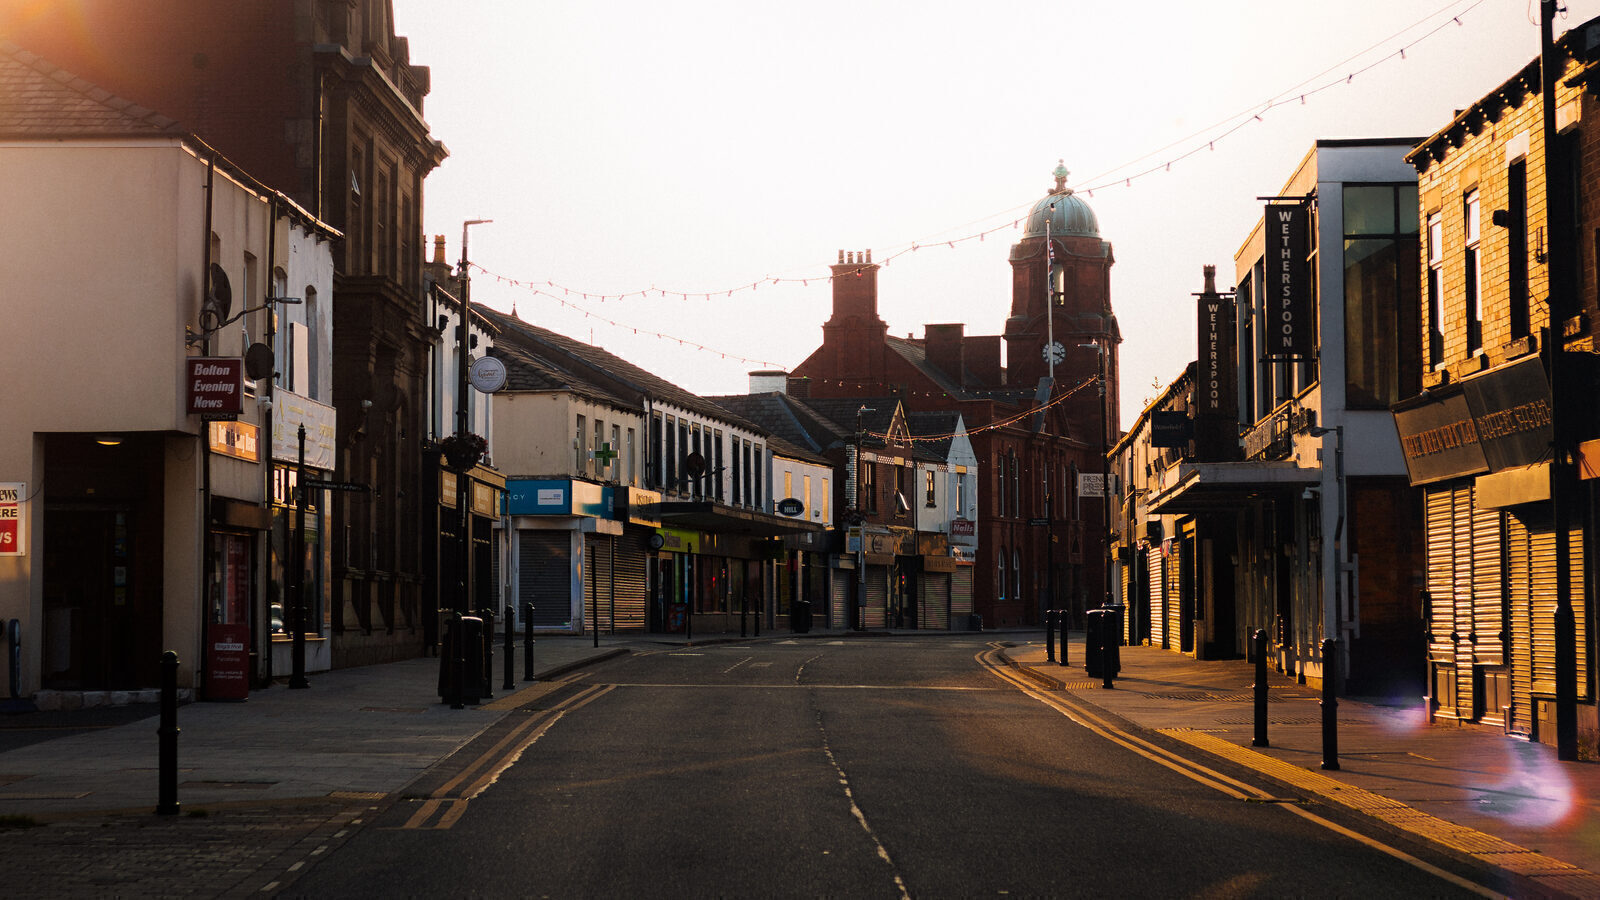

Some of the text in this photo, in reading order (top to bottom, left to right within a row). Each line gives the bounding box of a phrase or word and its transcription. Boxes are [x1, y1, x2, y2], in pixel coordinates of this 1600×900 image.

[1278, 211, 1292, 347] WETHERSPOON
[1208, 303, 1219, 409] WETHERSPOON
[194, 363, 230, 376] Bolton
[193, 380, 235, 395] Evening
[193, 396, 223, 409] News
[953, 524, 974, 532] Nails
